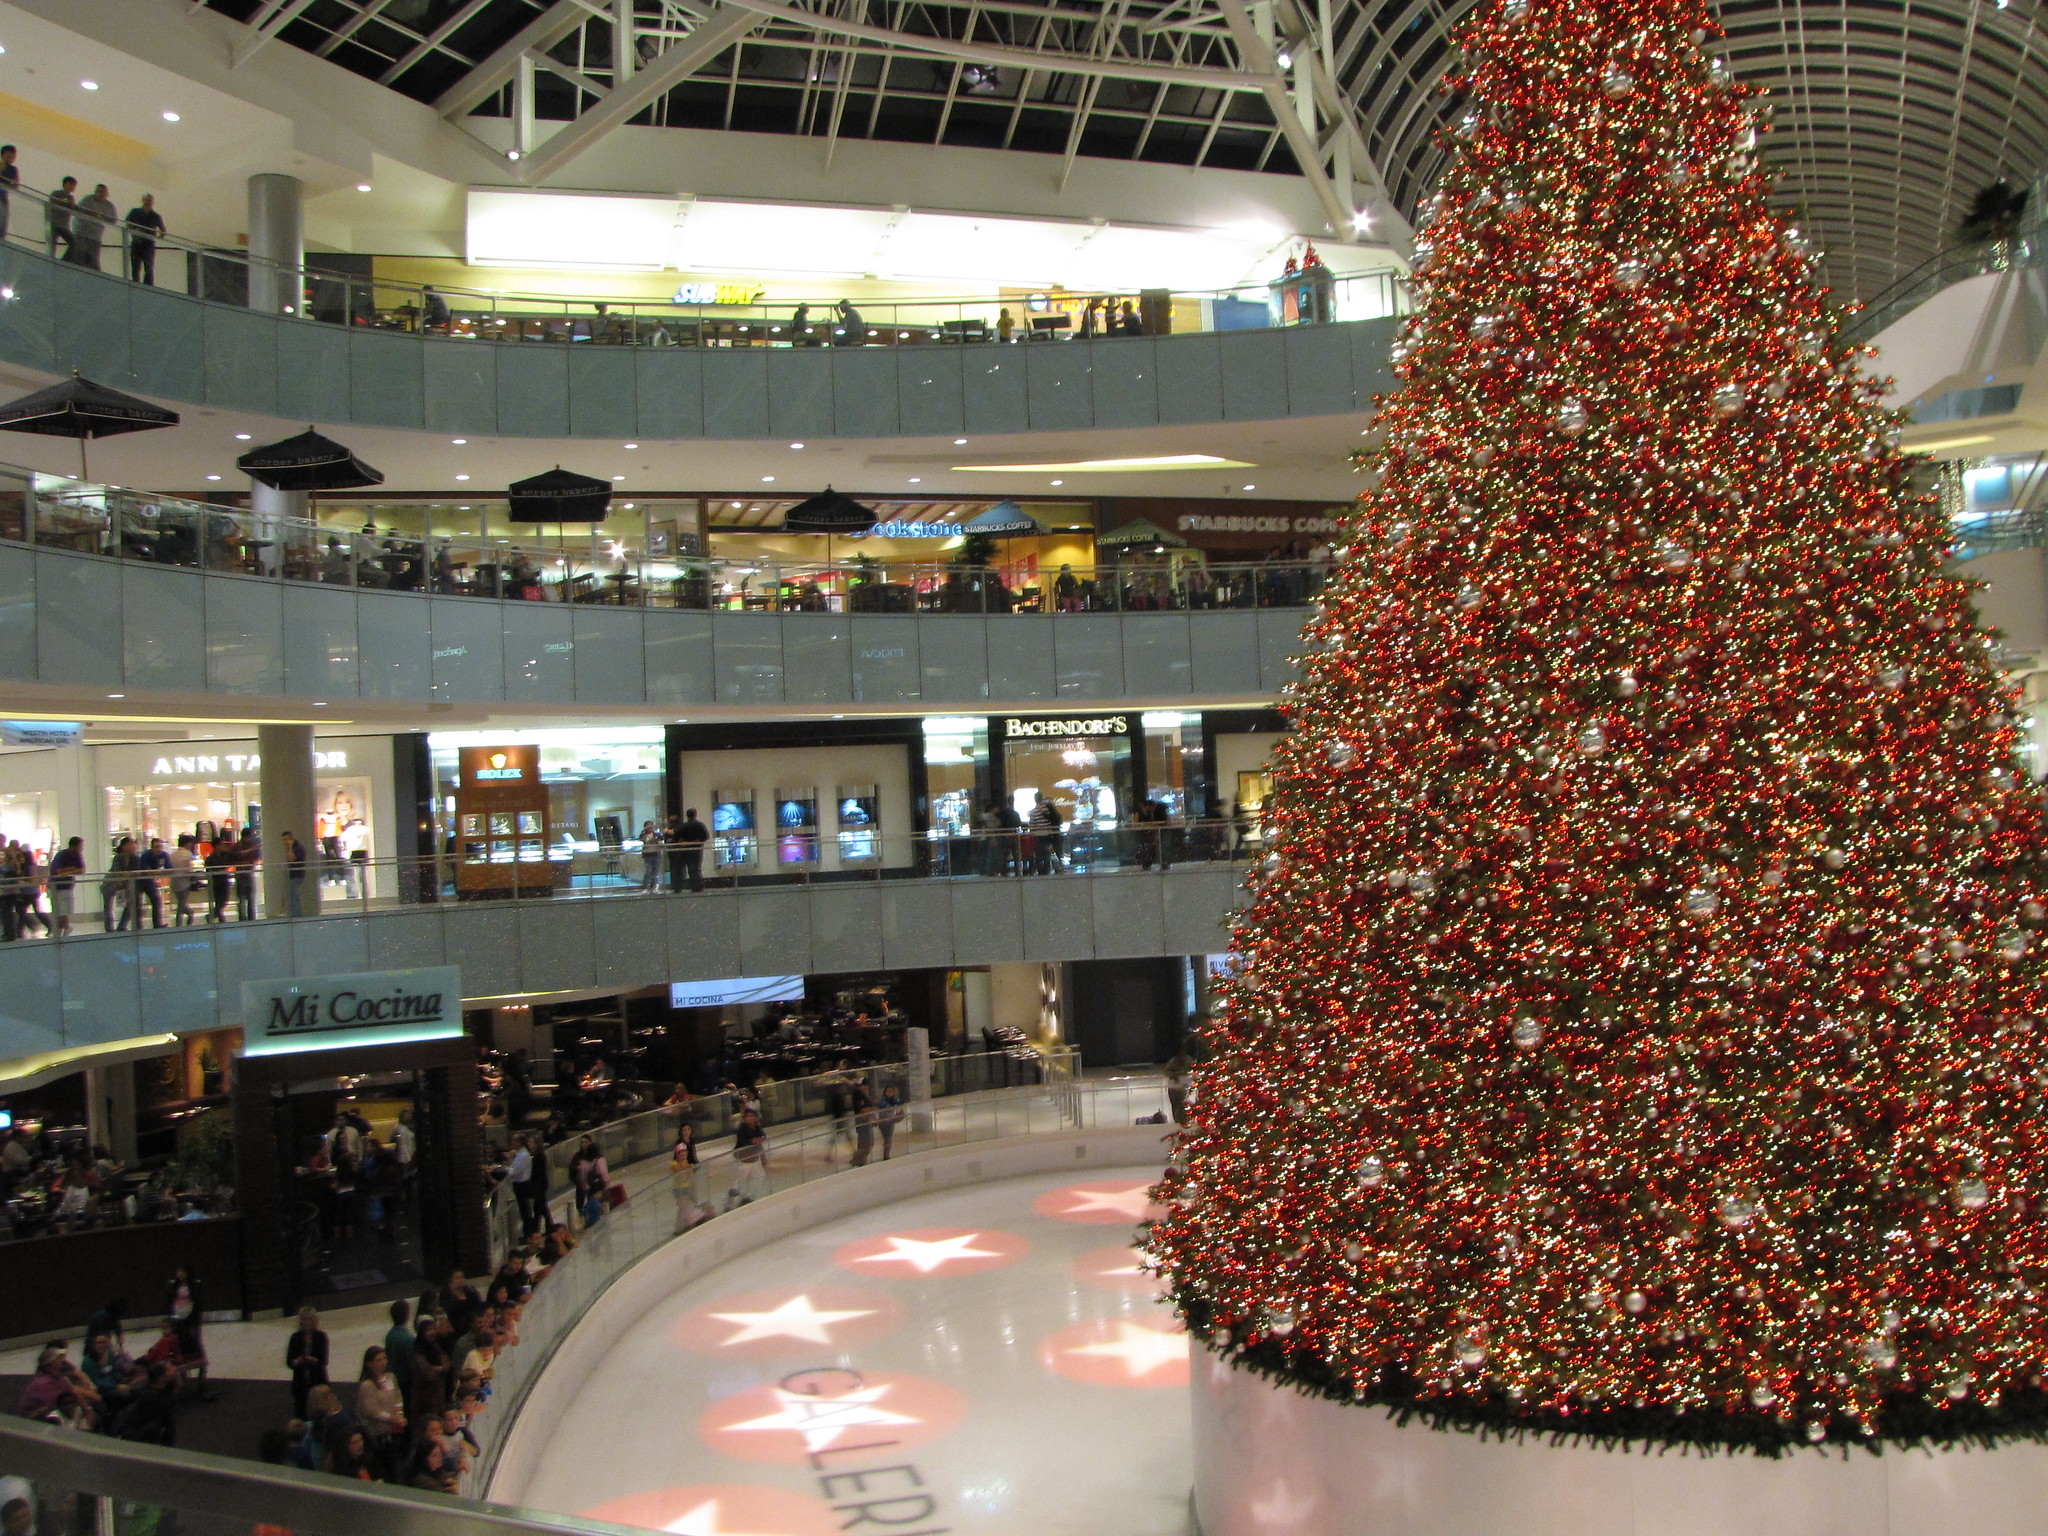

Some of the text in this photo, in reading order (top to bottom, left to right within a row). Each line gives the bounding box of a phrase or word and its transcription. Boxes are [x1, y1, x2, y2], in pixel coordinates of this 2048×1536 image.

[672, 283, 765, 305] SUBWAY
[851, 517, 964, 538] ookstone
[964, 524, 1005, 533] STARBUCKS
[1006, 521, 1031, 530] COFFEE
[1178, 515, 1290, 532] STARBUCKS
[1097, 536, 1131, 545] STARBUCKS
[1004, 716, 1128, 737] BACHENDORF'S
[153, 751, 347, 774] ANN TAOR
[476, 768, 522, 779] ROLEX
[267, 988, 443, 1029] Mi Cocina
[676, 996, 724, 1006] MI COCINA
